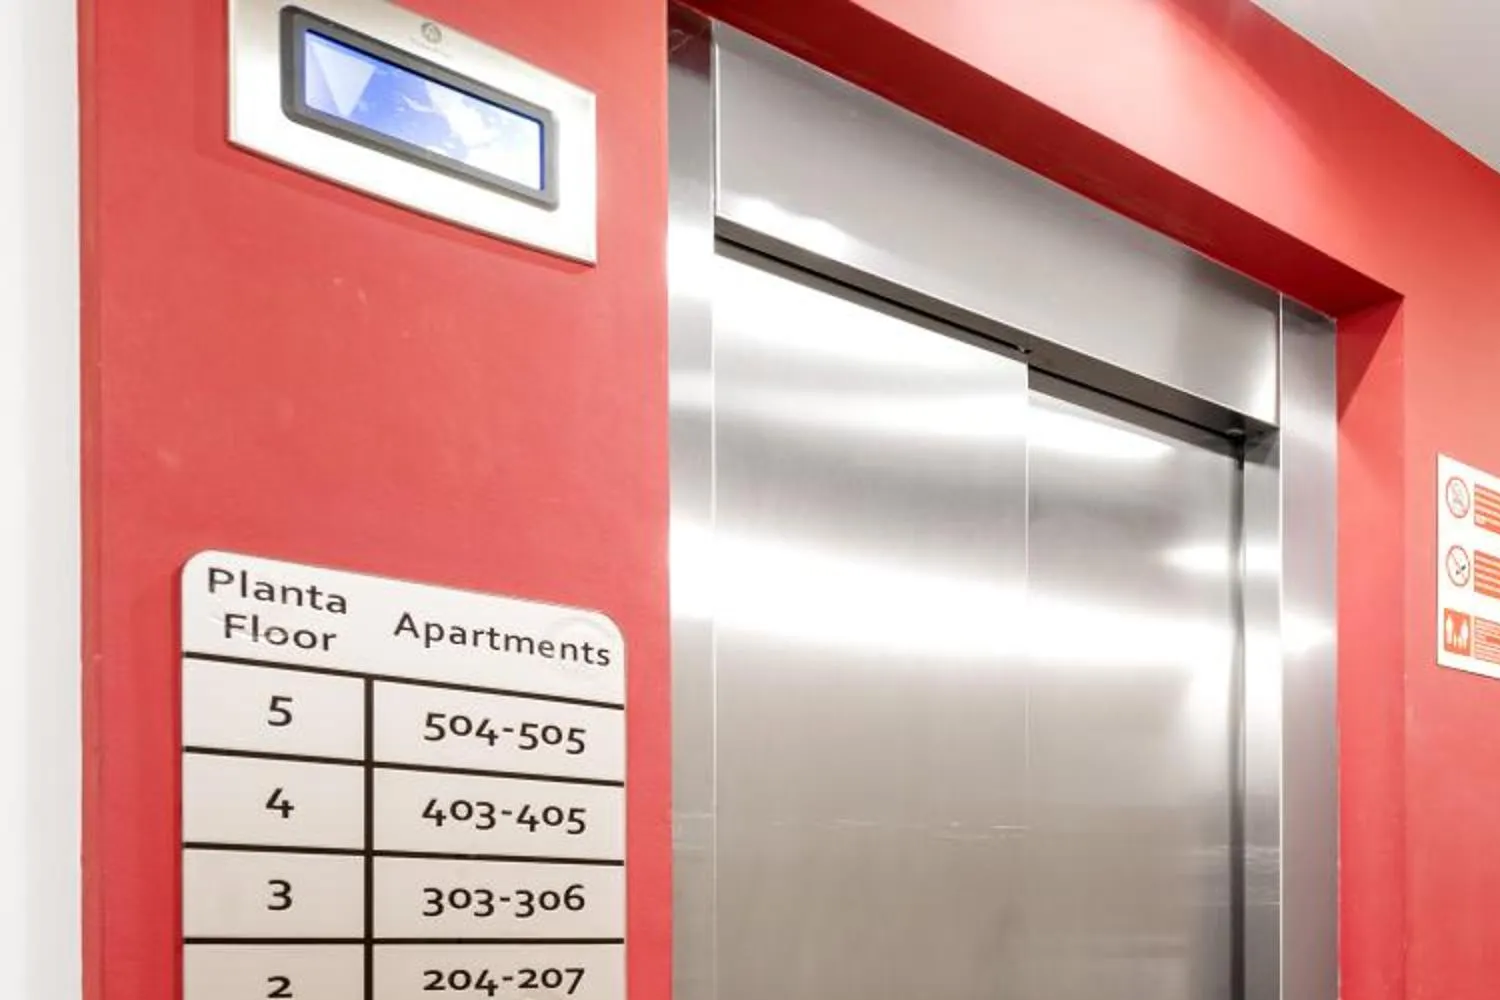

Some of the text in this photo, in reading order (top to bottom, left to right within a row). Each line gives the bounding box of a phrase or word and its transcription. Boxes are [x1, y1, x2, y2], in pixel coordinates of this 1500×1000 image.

[208, 567, 348, 615] Planta
[223, 613, 337, 652] Floor
[393, 611, 611, 667] Apartments
[267, 695, 293, 727] 5
[423, 711, 587, 755] 504-505
[265, 787, 295, 819] 4
[421, 798, 586, 835] 403-405
[267, 879, 293, 911] 3
[422, 883, 586, 919] 303-306
[267, 975, 293, 999] 2
[422, 967, 585, 998] 204-207
